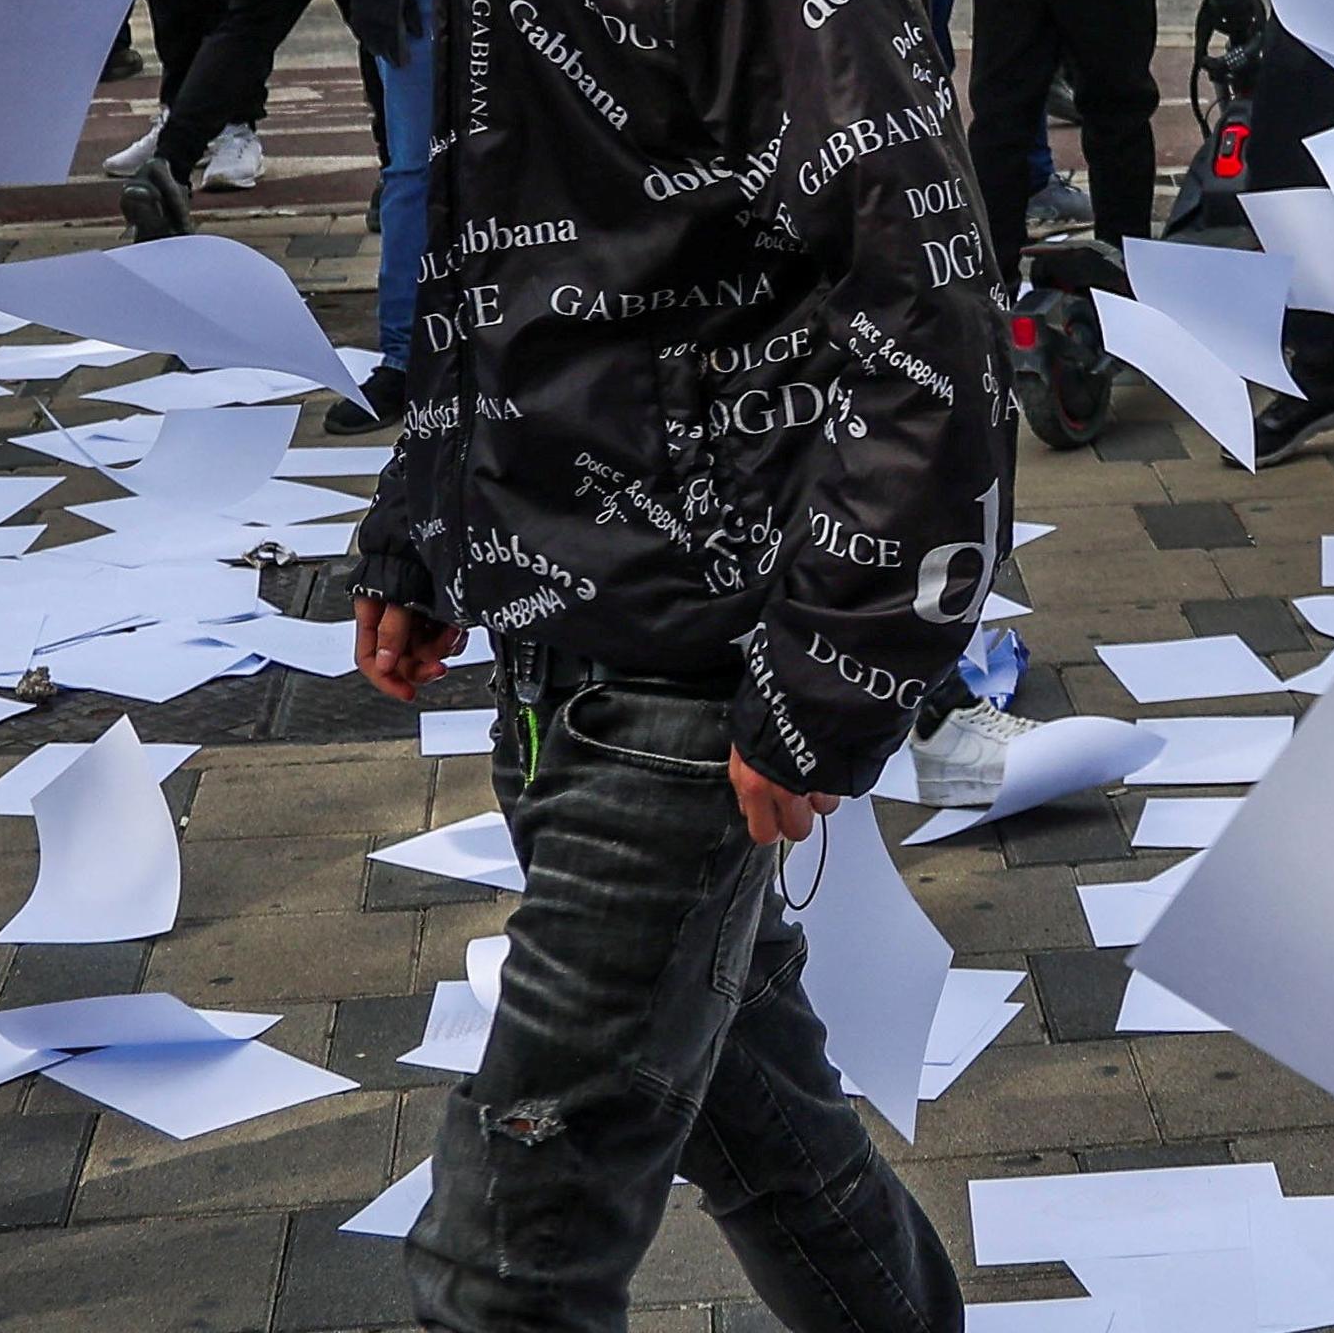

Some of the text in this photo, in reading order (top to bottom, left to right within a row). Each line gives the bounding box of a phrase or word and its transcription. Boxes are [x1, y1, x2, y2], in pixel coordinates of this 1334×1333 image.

[797, 104, 944, 196] GABBANA
[550, 272, 777, 322] GABBANA
[805, 631, 928, 710] DGDG
